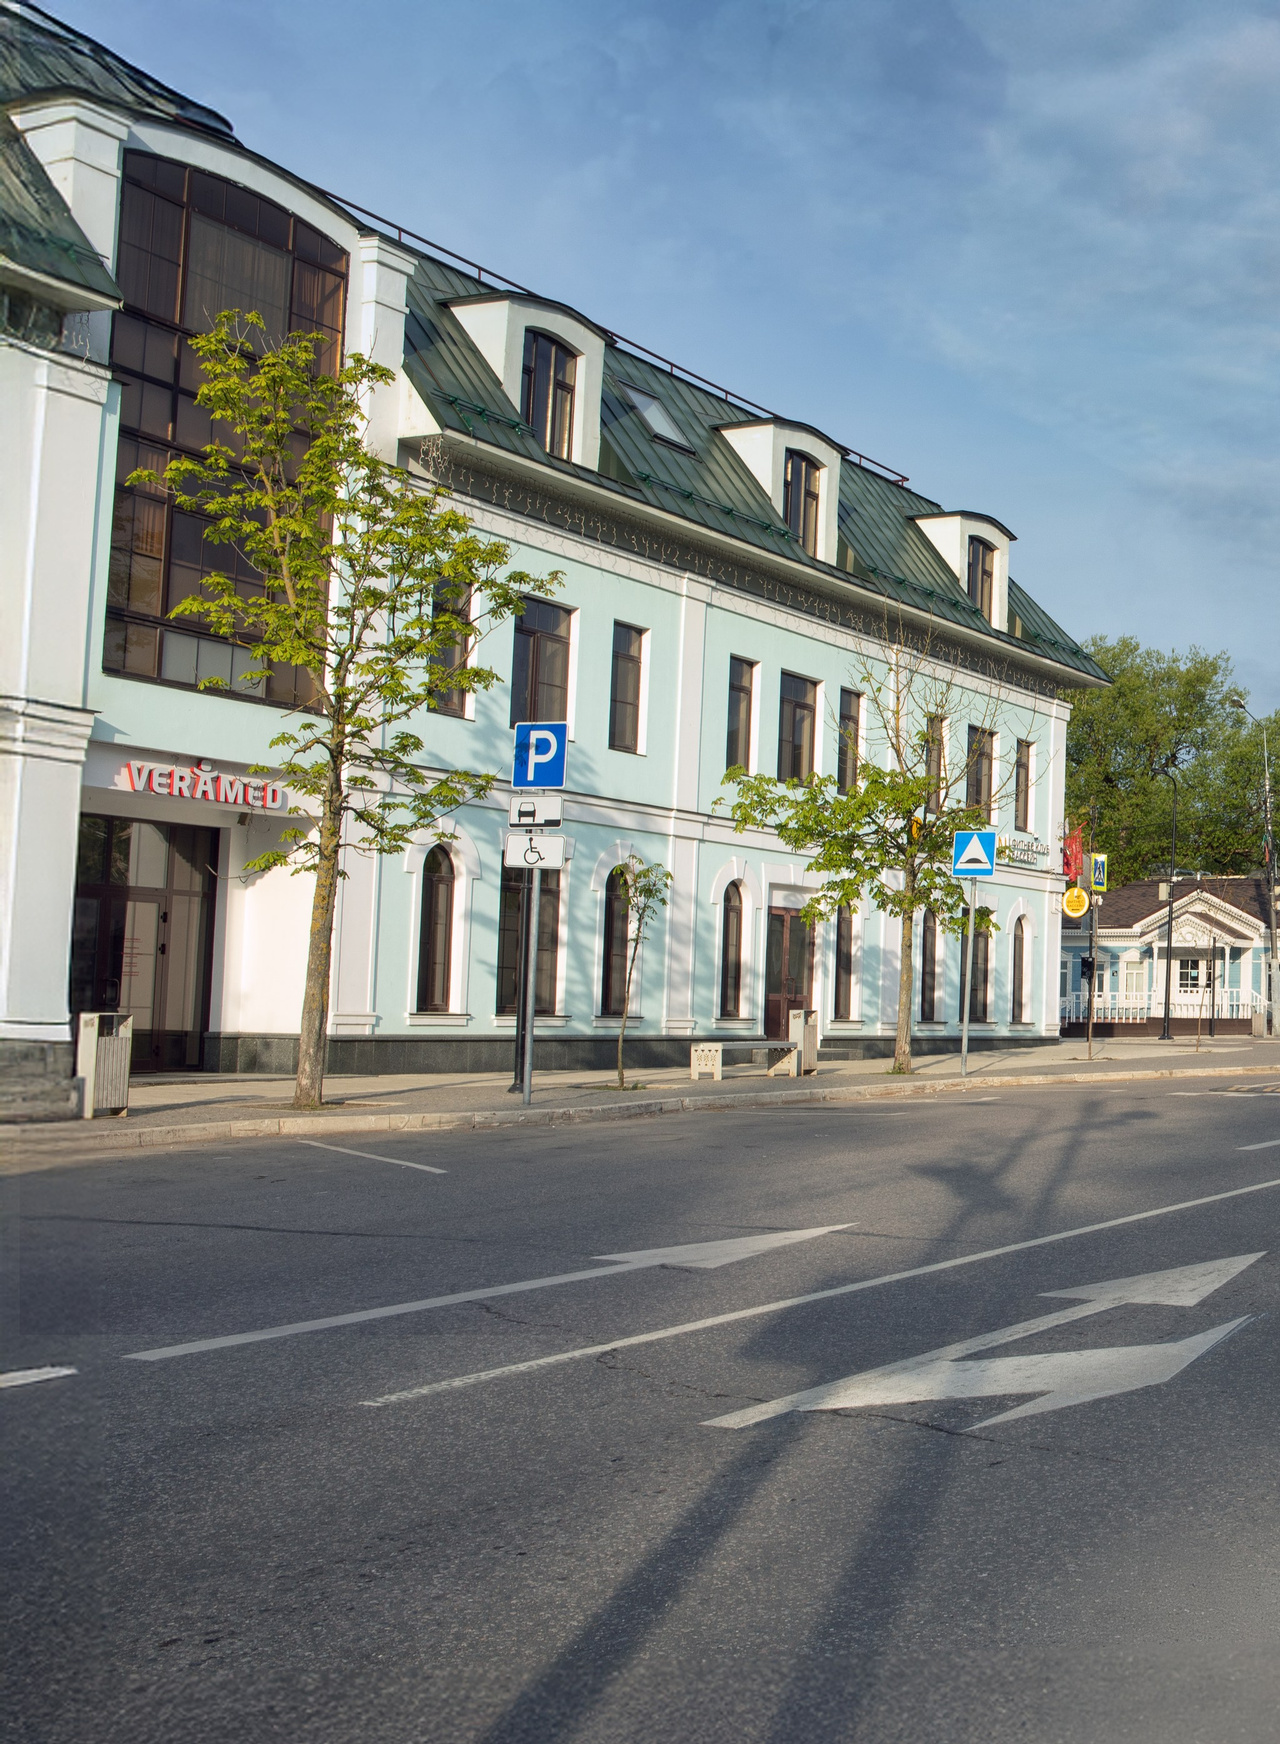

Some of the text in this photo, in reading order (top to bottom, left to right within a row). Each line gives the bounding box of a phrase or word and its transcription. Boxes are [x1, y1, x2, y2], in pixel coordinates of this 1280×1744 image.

[527, 730, 557, 781] P
[1011, 838, 1034, 851] ФИТНЕС
[1035, 843, 1050, 854] КЛУБ
